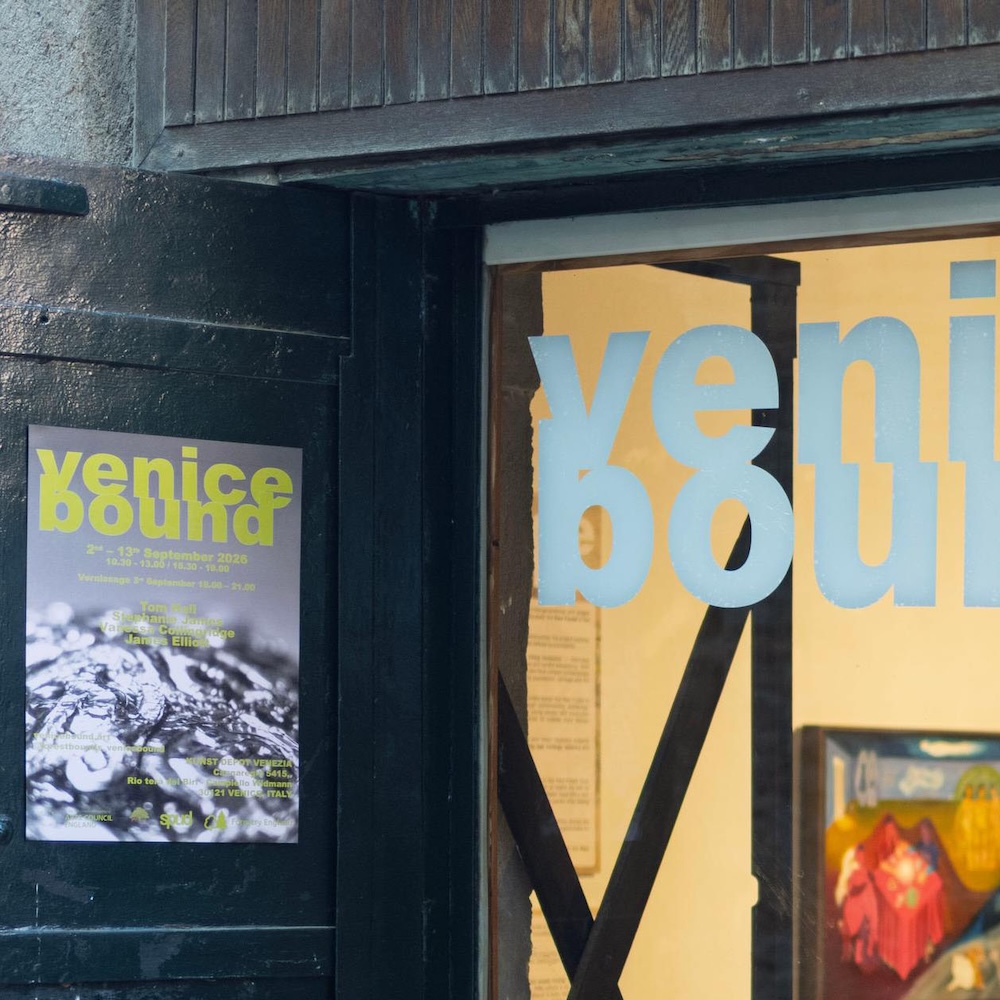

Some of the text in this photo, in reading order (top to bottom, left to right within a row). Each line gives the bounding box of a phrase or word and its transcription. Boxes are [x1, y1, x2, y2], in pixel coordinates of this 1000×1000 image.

[36, 446, 293, 509] venice
[39, 474, 273, 547] bound
[143, 547, 214, 563] September
[217, 552, 248, 564] 2026
[106, 557, 132, 567] 10.30
[139, 559, 165, 569] 13.00
[77, 573, 130, 585] Vernissage
[146, 577, 195, 588] September
[140, 600, 168, 613] Tom
[100, 621, 155, 634] Vanessa
[181, 616, 223, 627] James
[125, 633, 168, 645] James
[186, 757, 293, 768] KUNST DEPOT VENEZIA
[127, 777, 143, 785] Rio
[266, 789, 293, 798] ITALY
[84, 814, 114, 822] COUNCIL
[159, 810, 193, 829] spud
